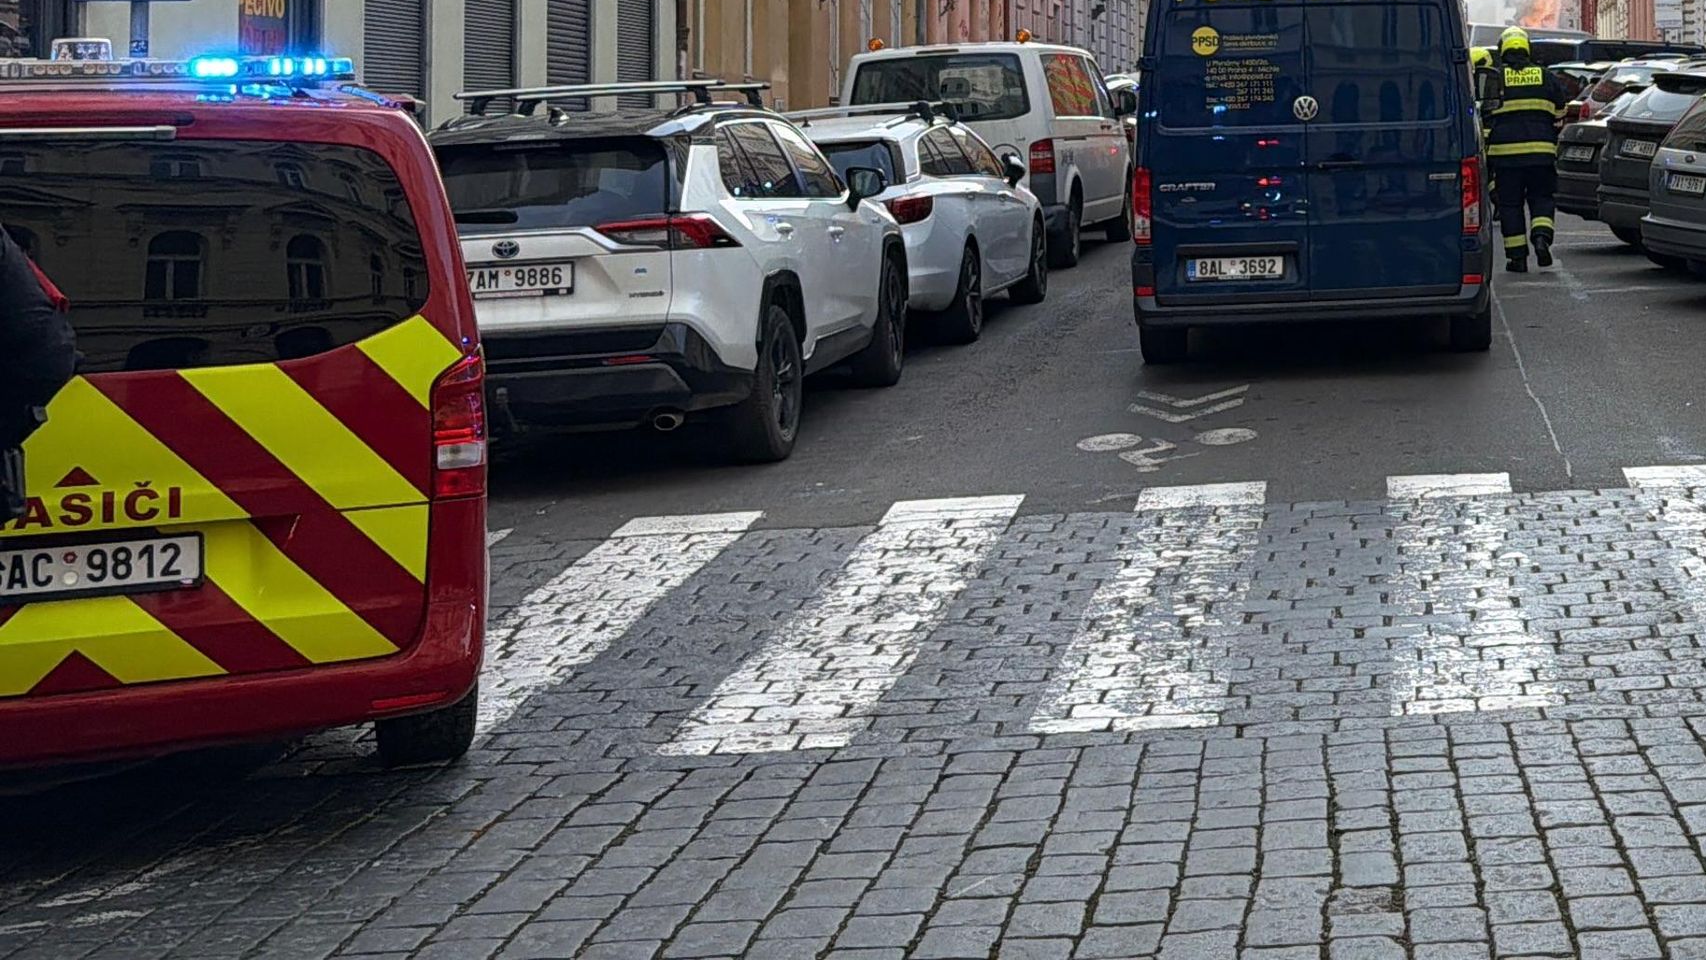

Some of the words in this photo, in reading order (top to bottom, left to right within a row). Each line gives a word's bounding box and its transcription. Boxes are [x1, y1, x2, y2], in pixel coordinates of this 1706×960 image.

[1507, 76, 1541, 84] PRAHA
[1159, 182, 1216, 192] CRAFTER
[514, 266, 562, 287] 9886
[1199, 260, 1227, 276] 8AL
[1239, 258, 1276, 274] 3692
[0, 481, 182, 531] ASIČI
[86, 542, 182, 583] 9812
